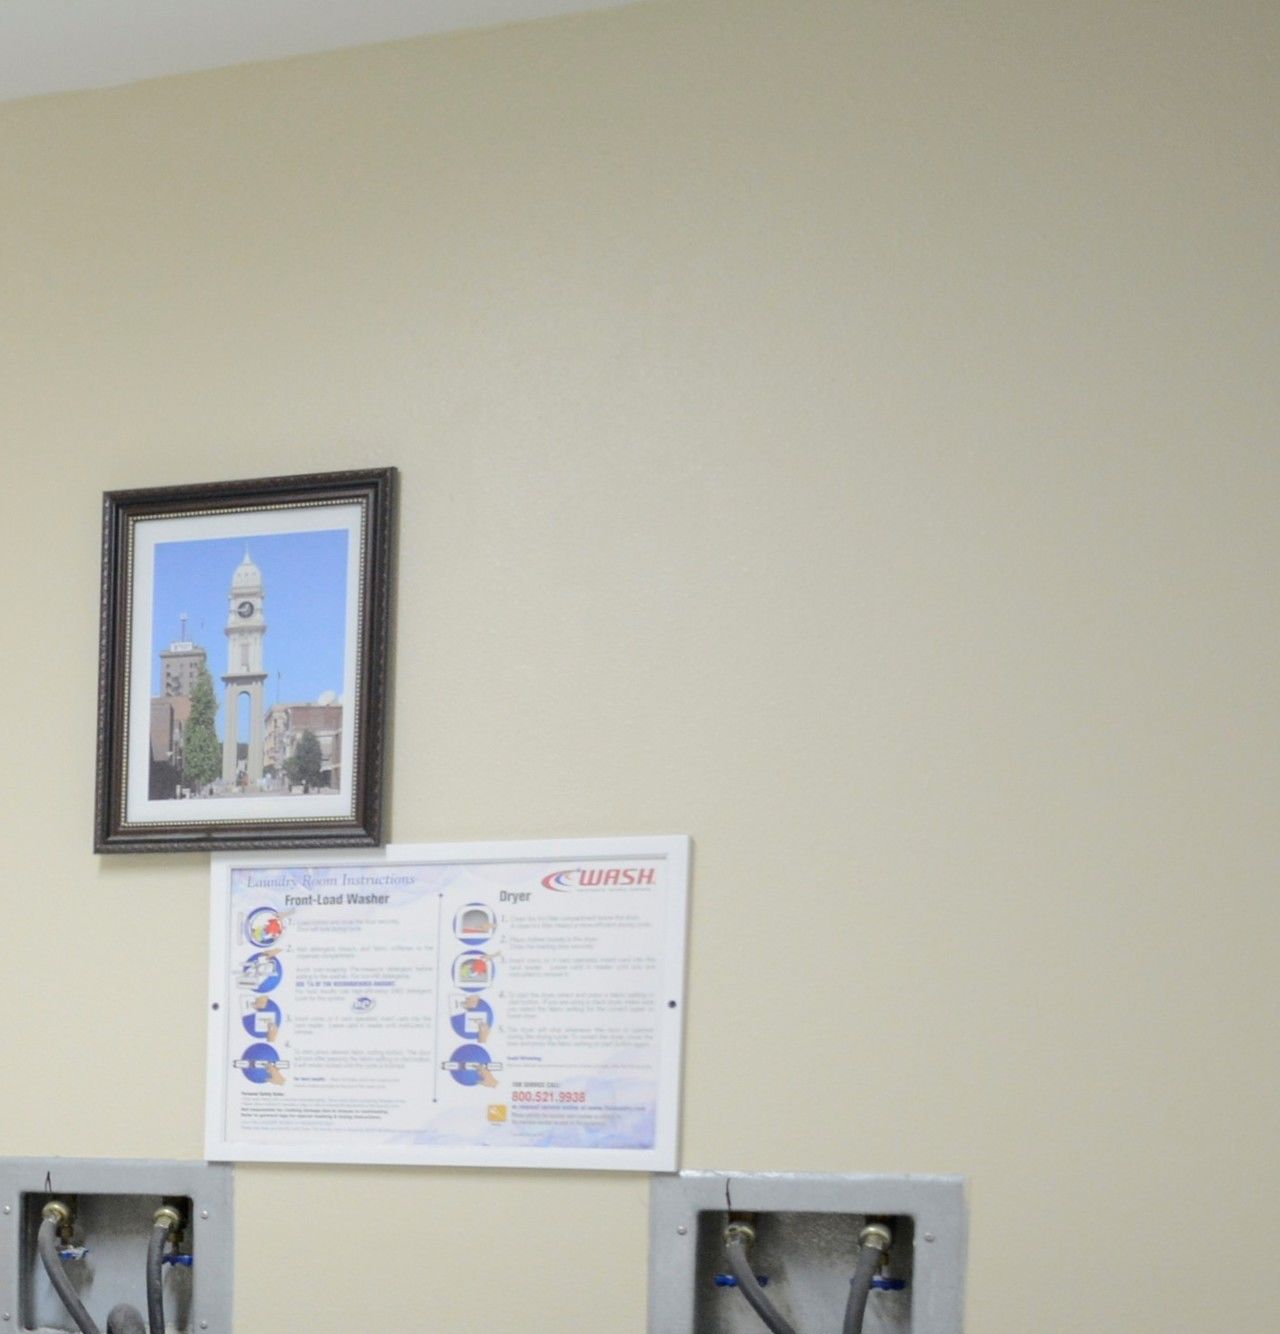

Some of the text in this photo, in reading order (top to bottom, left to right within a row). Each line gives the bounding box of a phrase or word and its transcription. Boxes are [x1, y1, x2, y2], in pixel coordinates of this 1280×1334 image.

[247, 873, 416, 890] Laundry Room Instructions
[579, 868, 656, 887] WASH
[285, 893, 390, 906] Front-Load Washer
[499, 890, 532, 905] Dryer
